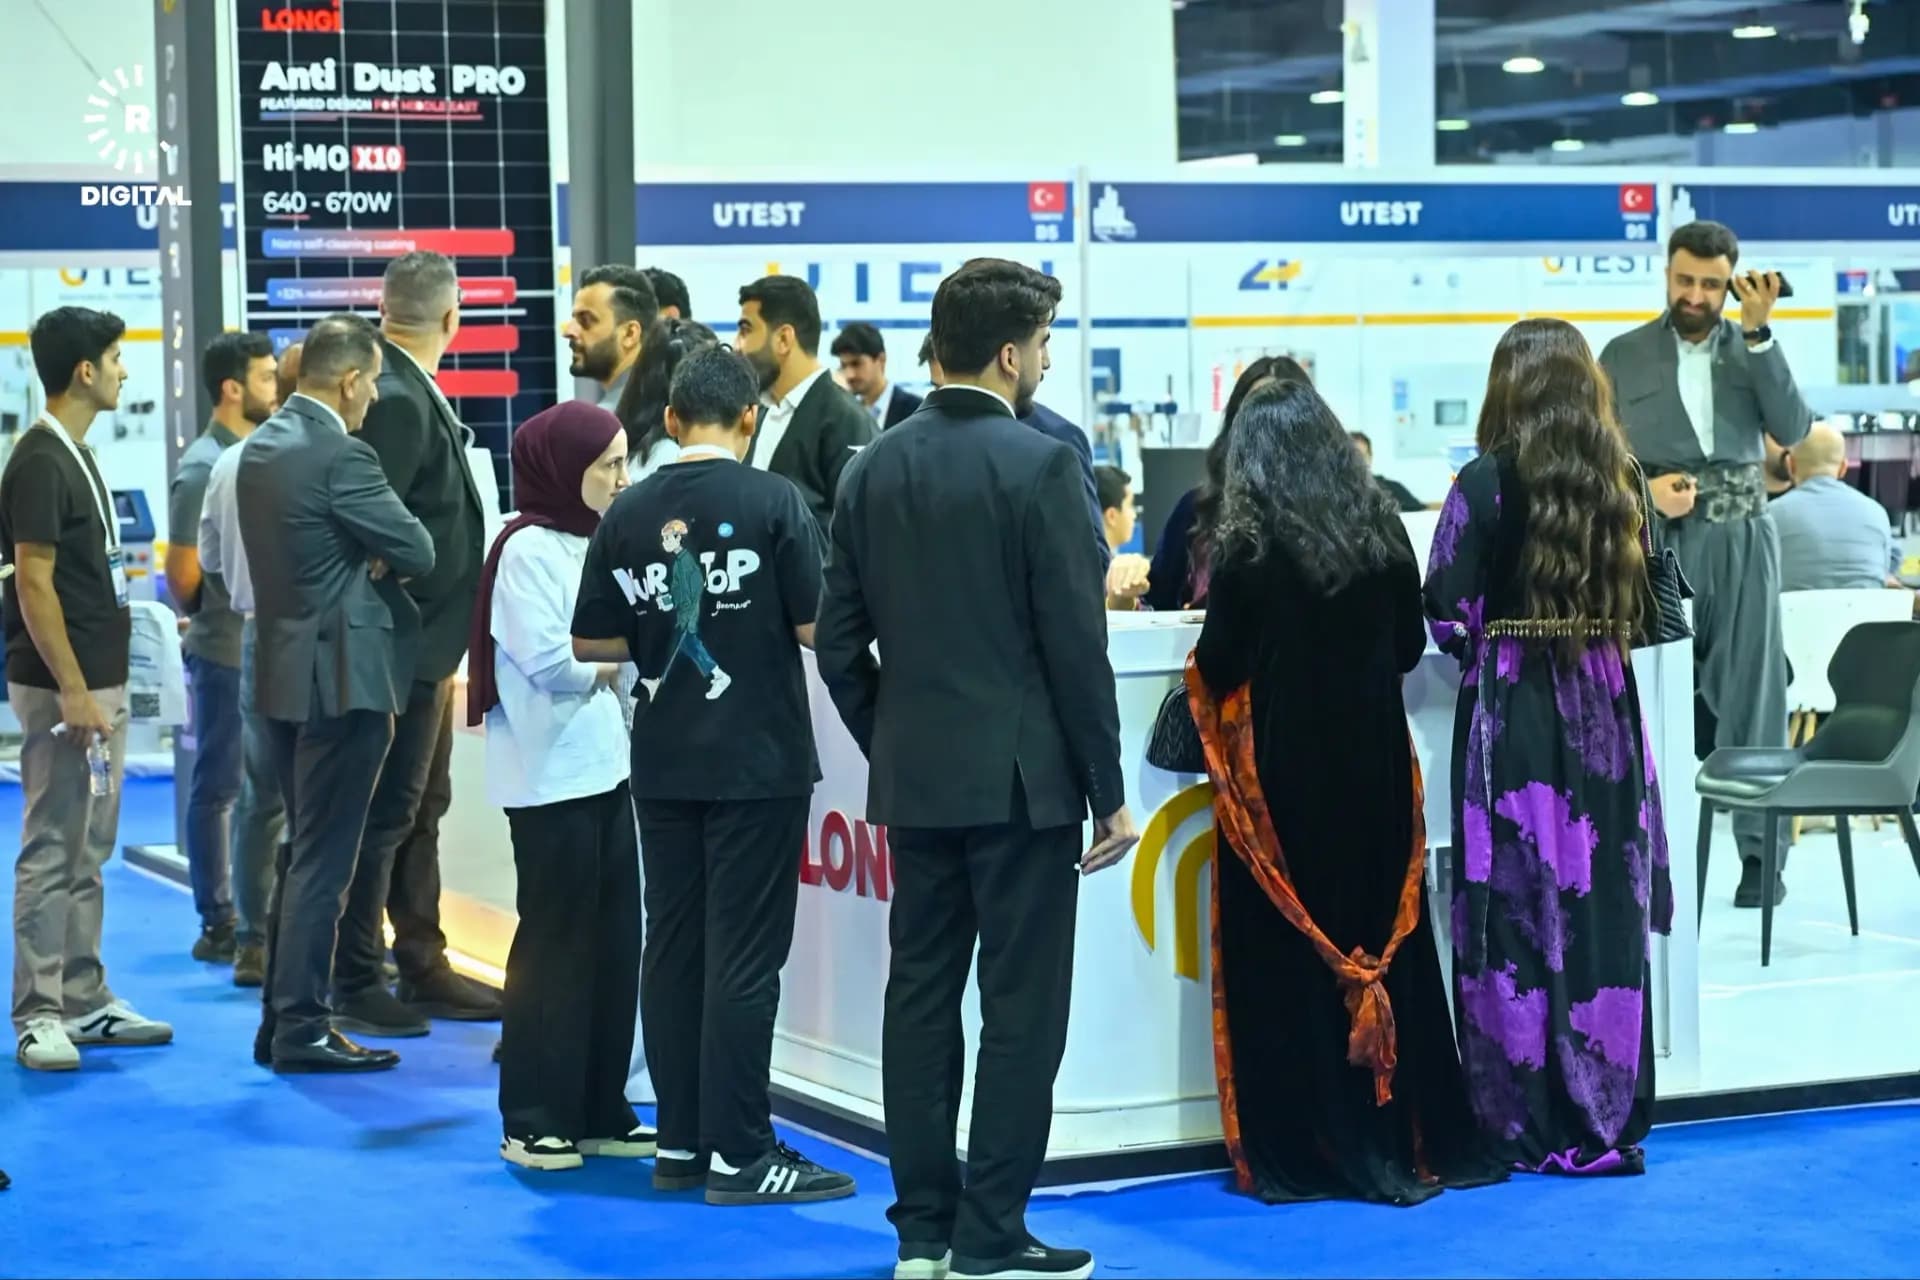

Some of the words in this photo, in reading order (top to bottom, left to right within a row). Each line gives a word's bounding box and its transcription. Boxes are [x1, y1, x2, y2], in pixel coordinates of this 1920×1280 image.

[259, 57, 336, 91] Anti
[353, 62, 436, 93] Dust
[452, 65, 526, 95] PRO
[260, 97, 325, 111] FEATURED
[327, 98, 372, 111] DESIGN
[263, 142, 350, 171] Hi-MO
[355, 146, 403, 171] X10
[262, 191, 308, 213] 640
[325, 191, 393, 213] 670W
[713, 201, 805, 228] UTEST
[1339, 200, 1423, 226] UTEST
[1887, 203, 1920, 227] UT
[799, 808, 896, 902] LON
